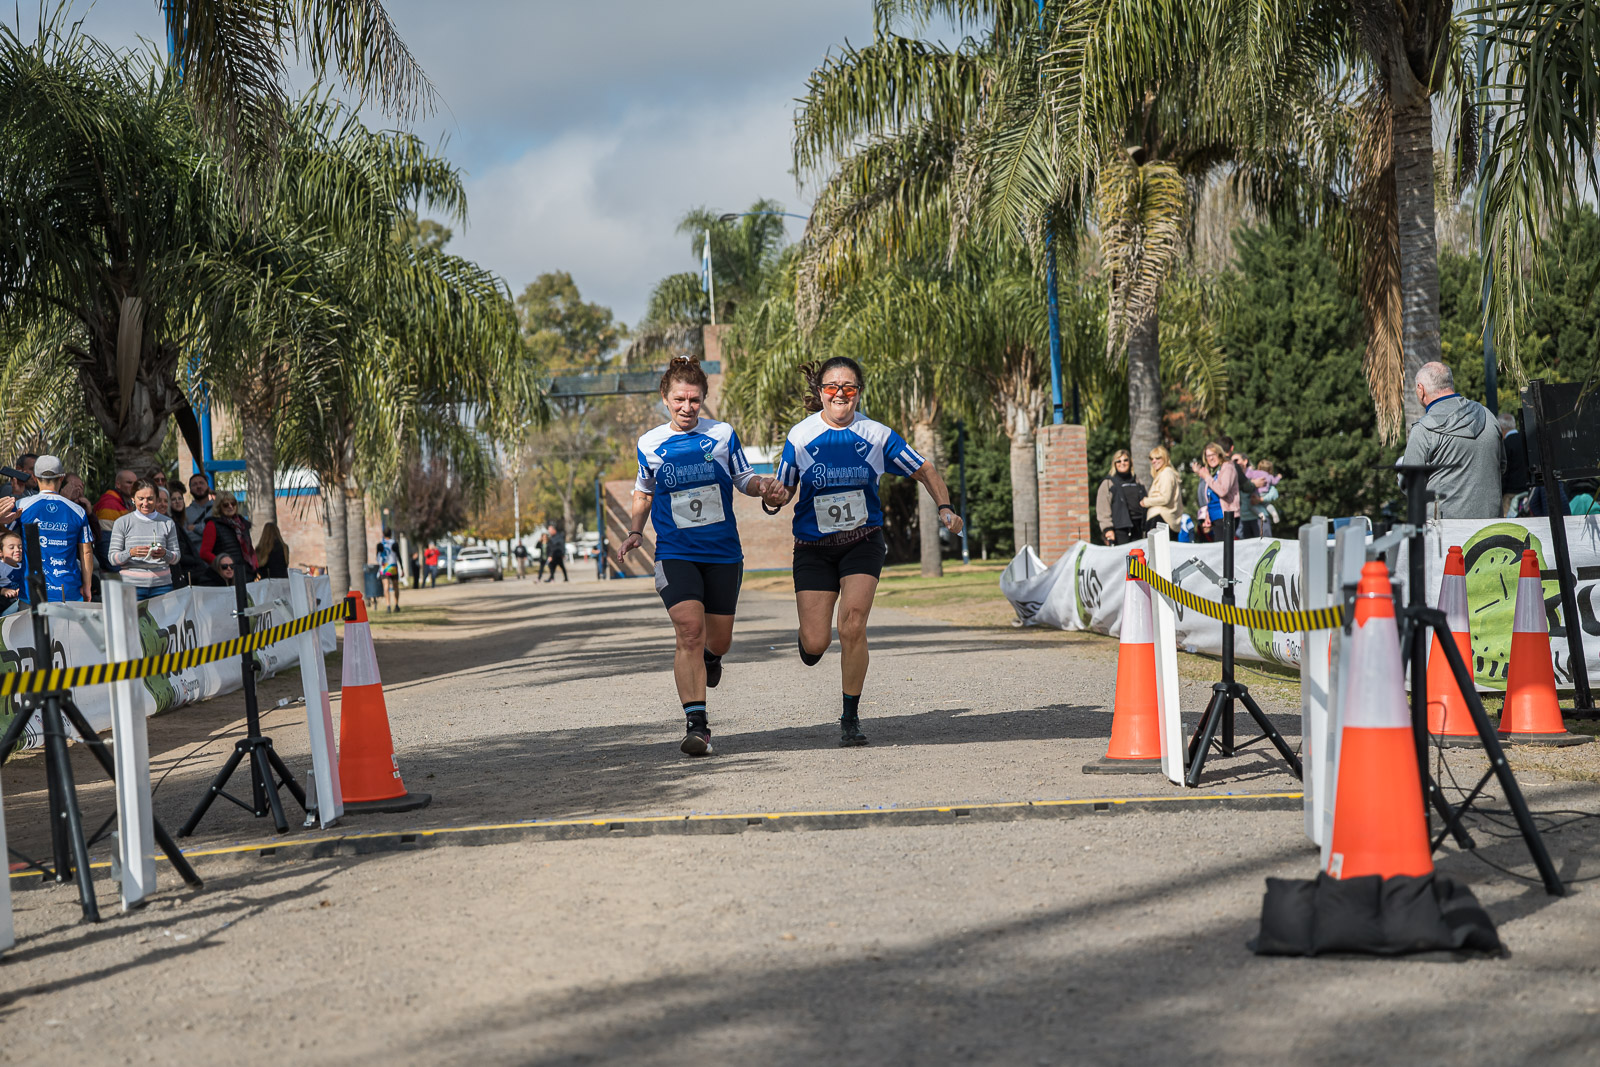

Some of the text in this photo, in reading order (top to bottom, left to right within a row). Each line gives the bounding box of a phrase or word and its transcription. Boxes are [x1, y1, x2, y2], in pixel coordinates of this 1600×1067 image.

[662, 462, 677, 488] 3
[812, 462, 827, 490] 3
[689, 498, 703, 518] 9
[827, 502, 856, 523] 91
